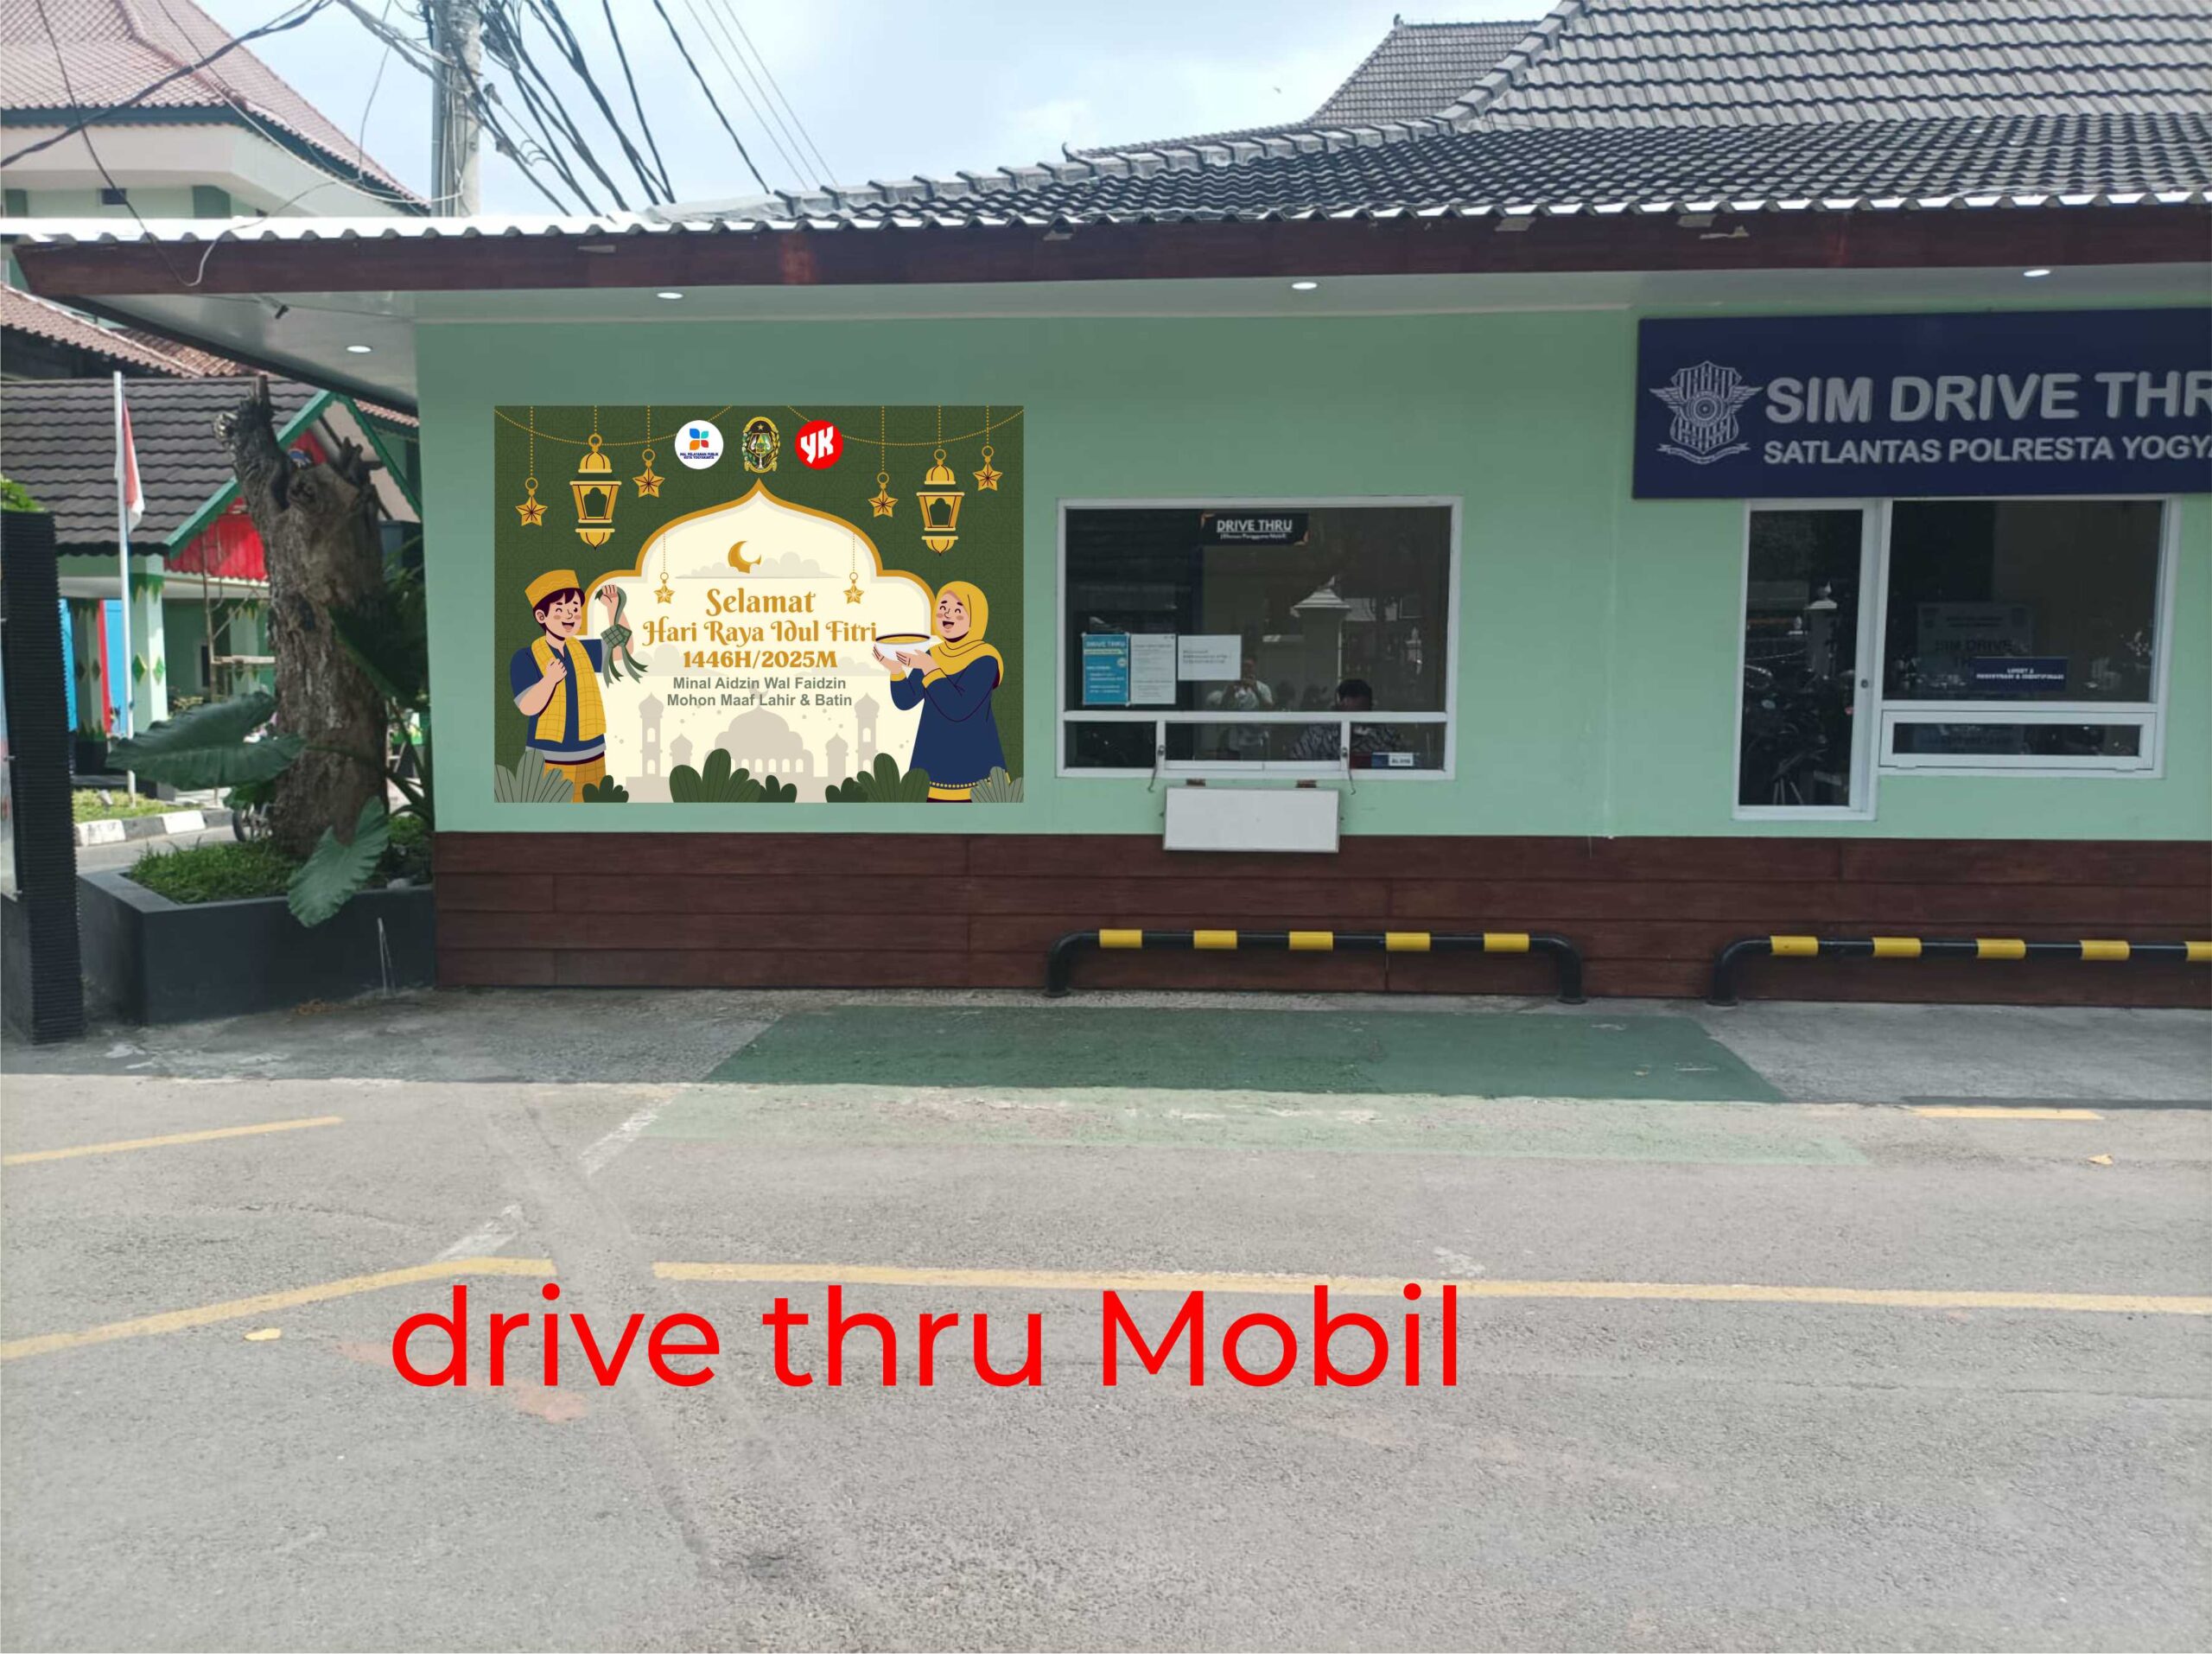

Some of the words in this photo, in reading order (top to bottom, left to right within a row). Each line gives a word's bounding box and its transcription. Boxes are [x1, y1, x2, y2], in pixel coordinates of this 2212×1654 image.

[1765, 378, 1873, 423] SIM
[1890, 373, 2082, 422] DRIVE
[2094, 371, 2211, 419] THR
[1764, 440, 1942, 464] SATLANTAS
[1948, 437, 2115, 462] POLRESTA
[2121, 435, 2211, 461] YOGY
[1217, 519, 1255, 532] DRIVE
[1257, 519, 1293, 532] THRU
[706, 588, 816, 617] Selamat
[642, 616, 697, 646] Hari
[703, 620, 765, 647] Raya
[770, 620, 820, 642] Idul
[825, 620, 877, 642] Fitri
[683, 650, 838, 669] 1446H/2025M
[673, 677, 711, 690] Minal
[715, 677, 760, 690] Aidzin
[764, 677, 790, 690] Wal
[794, 677, 846, 690] Faidzin
[667, 693, 715, 706] Mohon
[721, 693, 755, 706] Maaf
[759, 693, 796, 706] Lahir
[800, 693, 810, 706] &
[815, 693, 852, 706] Batin
